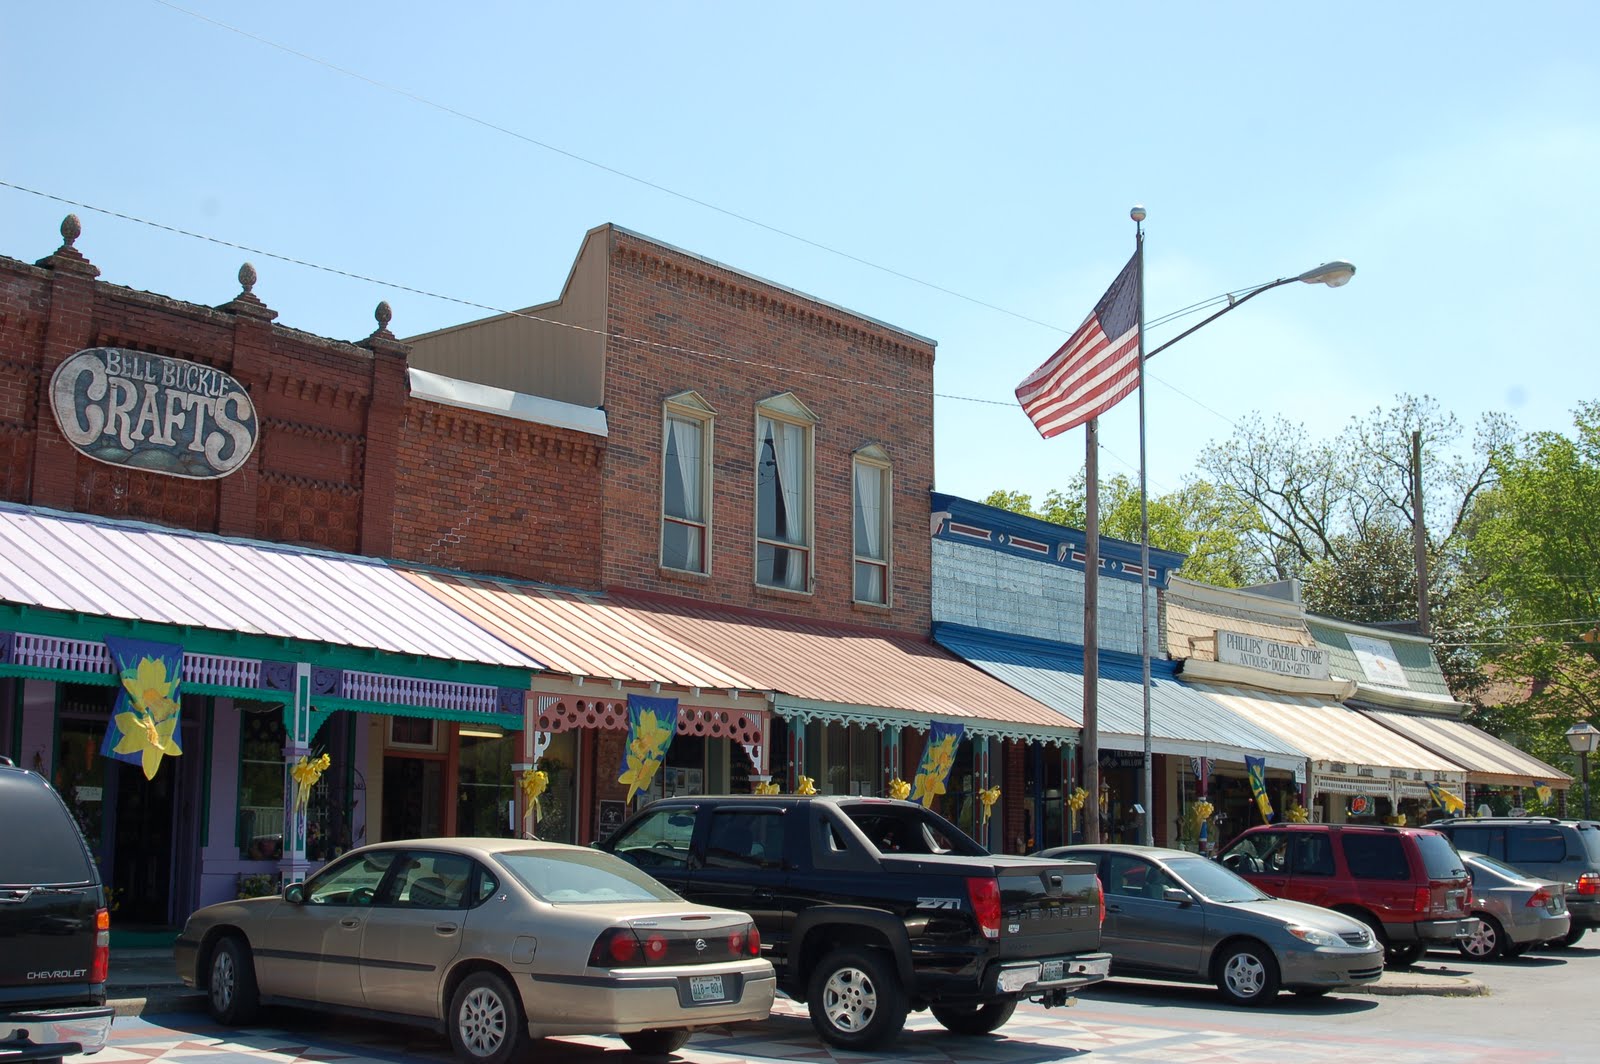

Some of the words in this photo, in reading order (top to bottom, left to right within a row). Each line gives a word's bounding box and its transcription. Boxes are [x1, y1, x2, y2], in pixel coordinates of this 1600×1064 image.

[104, 350, 157, 383] BELL
[160, 359, 231, 398] BUCKLE
[54, 354, 251, 472] CRAFTS
[1239, 652, 1268, 669] ANTIQUES
[1272, 658, 1291, 673] DOLLS
[1294, 663, 1310, 676] GIFTS
[1267, 643, 1299, 662] GENERAL
[1301, 648, 1323, 665] STORE
[916, 897, 961, 910] Z71
[1008, 905, 1096, 921] CHEVROLET
[27, 969, 87, 980] CHEVROLET
